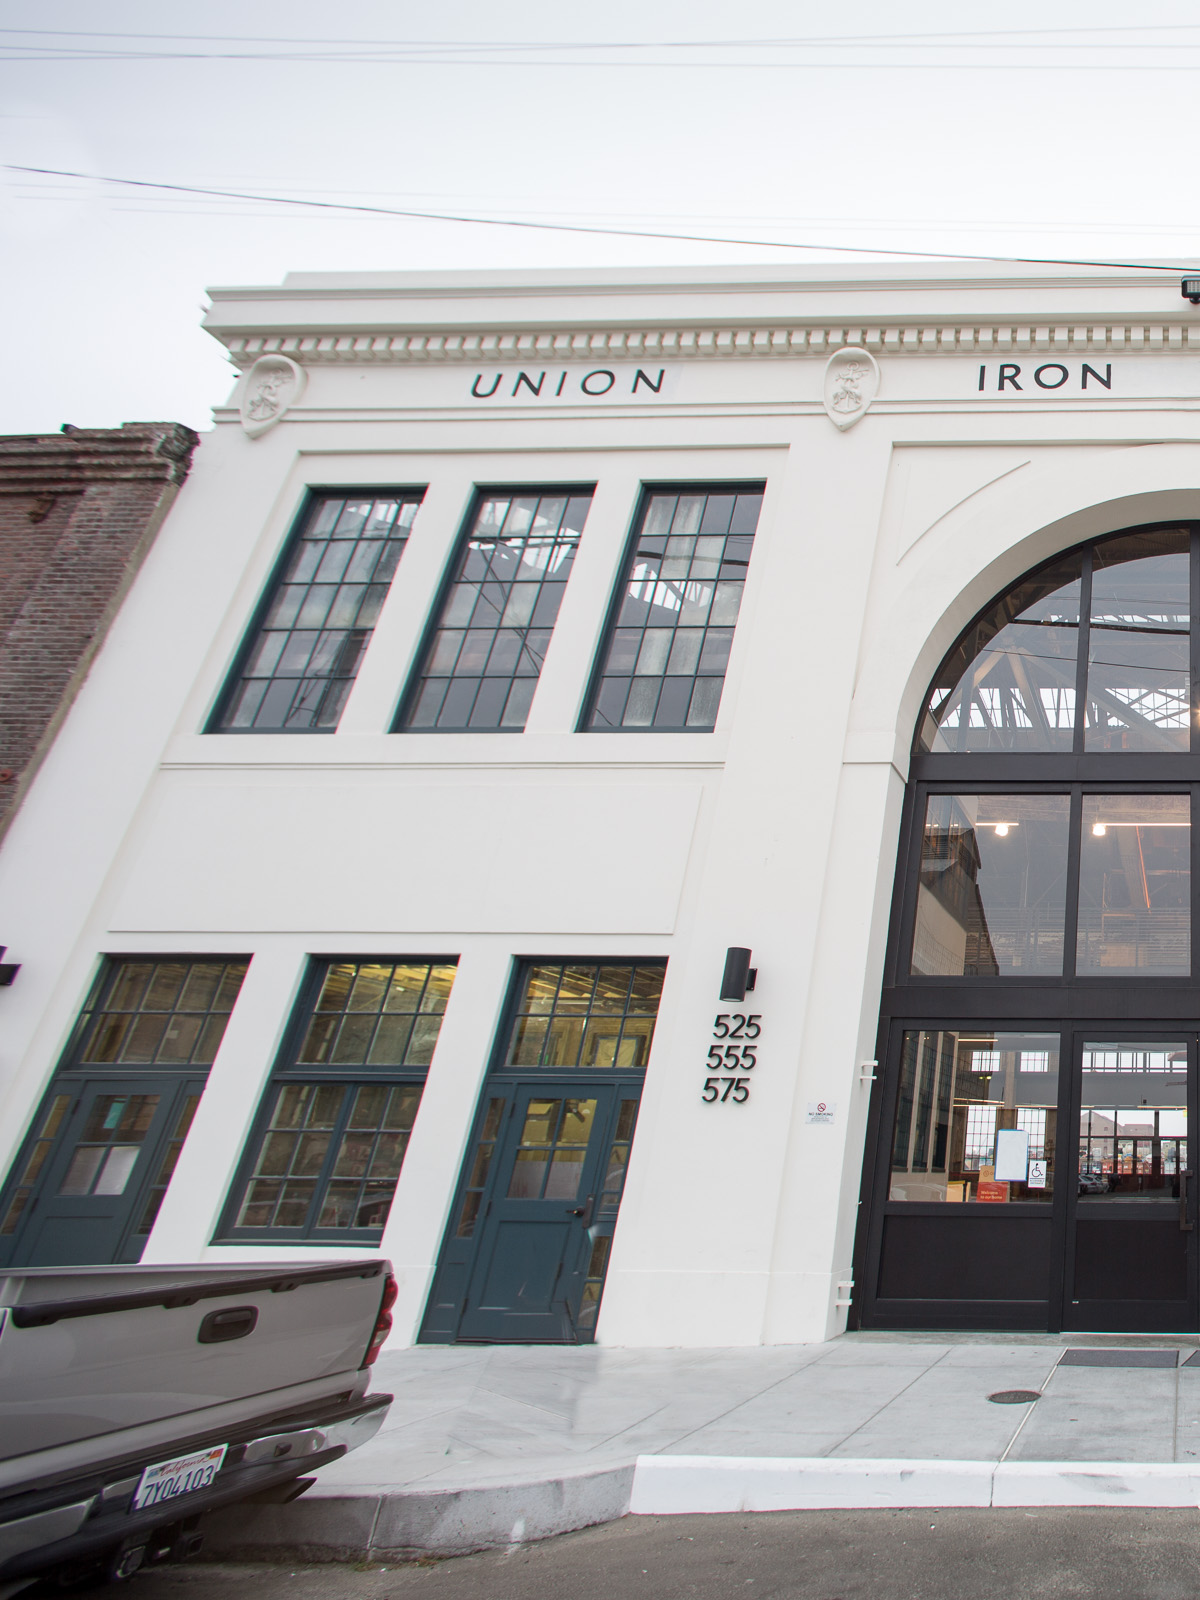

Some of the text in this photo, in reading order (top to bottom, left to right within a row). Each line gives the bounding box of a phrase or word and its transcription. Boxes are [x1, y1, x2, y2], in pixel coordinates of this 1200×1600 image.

[470, 368, 665, 398] UNION
[978, 363, 1112, 391] IRON
[713, 1014, 762, 1039] 525
[706, 1045, 758, 1070] 555
[701, 1077, 751, 1103] 575
[160, 1457, 209, 1477] California
[142, 1464, 214, 1507] 7Y04103
